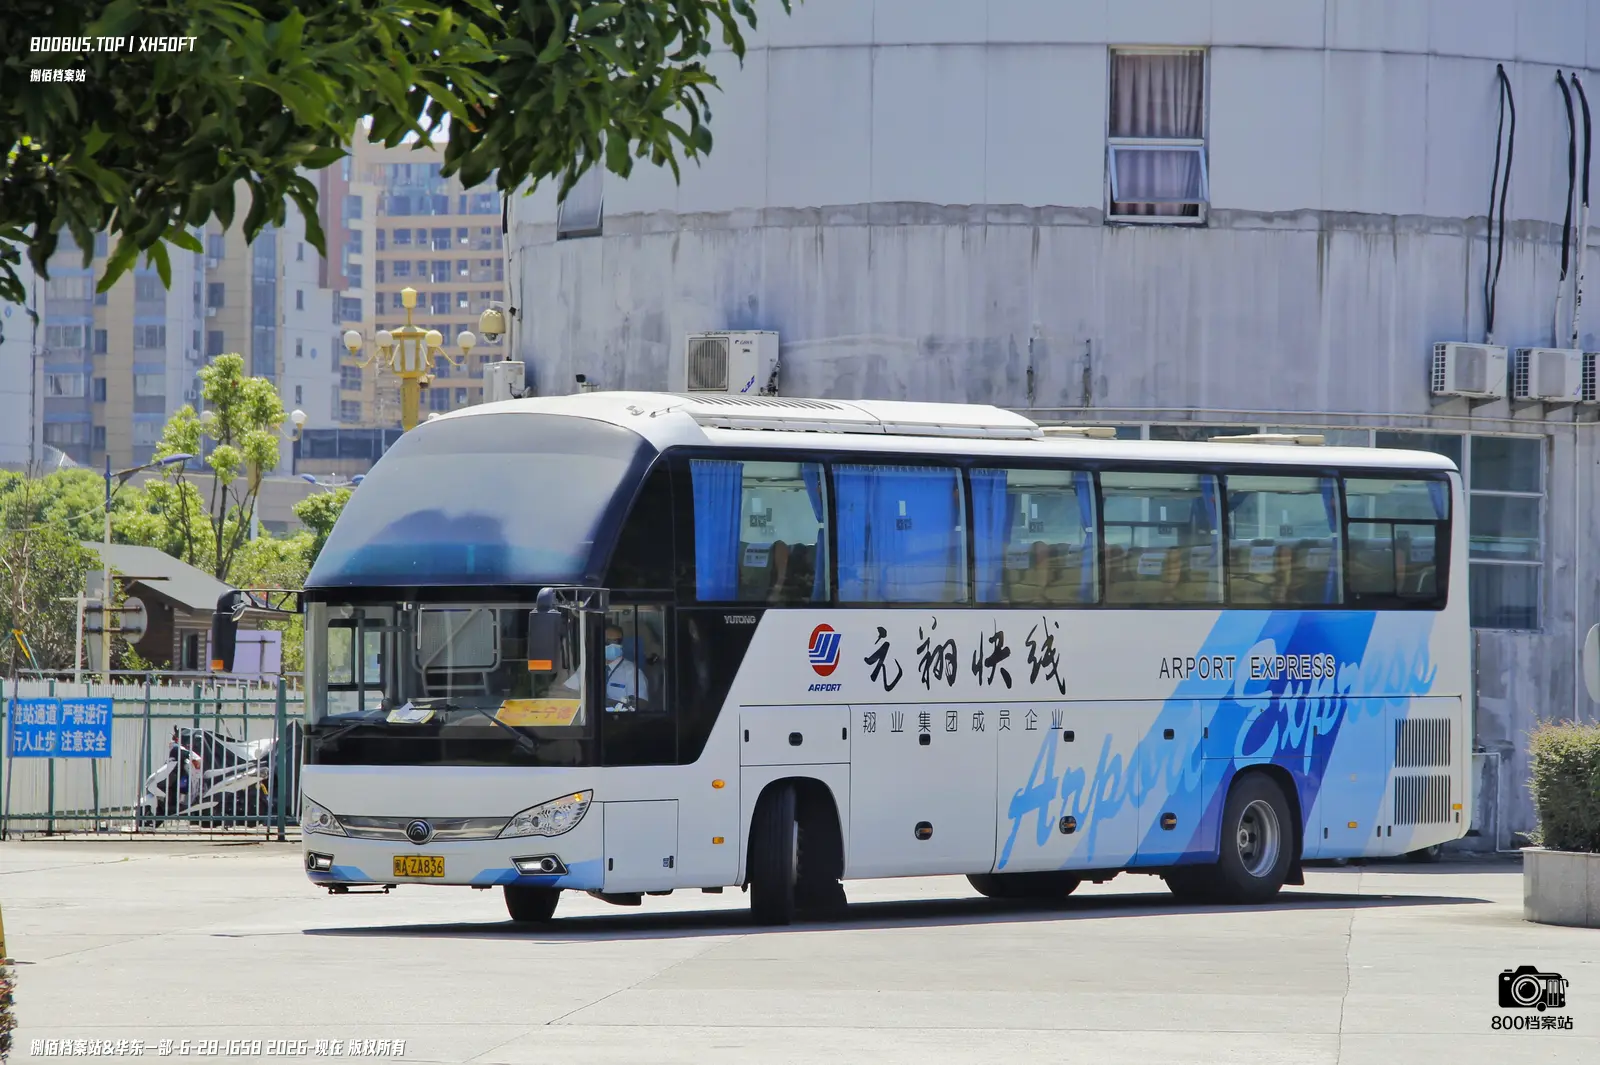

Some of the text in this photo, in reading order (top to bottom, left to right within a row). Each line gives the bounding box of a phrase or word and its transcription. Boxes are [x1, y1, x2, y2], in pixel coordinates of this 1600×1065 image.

[723, 615, 757, 625] YUTONG
[863, 615, 1066, 696] 元翔快线
[1158, 654, 1337, 680] ARPORT EXPRESS
[808, 683, 842, 692] ARPORT
[11, 703, 108, 725] 进站通道 严禁逆行
[863, 708, 1065, 733] 翔业集团成员企业
[12, 730, 107, 752] 行人止步 注意安全
